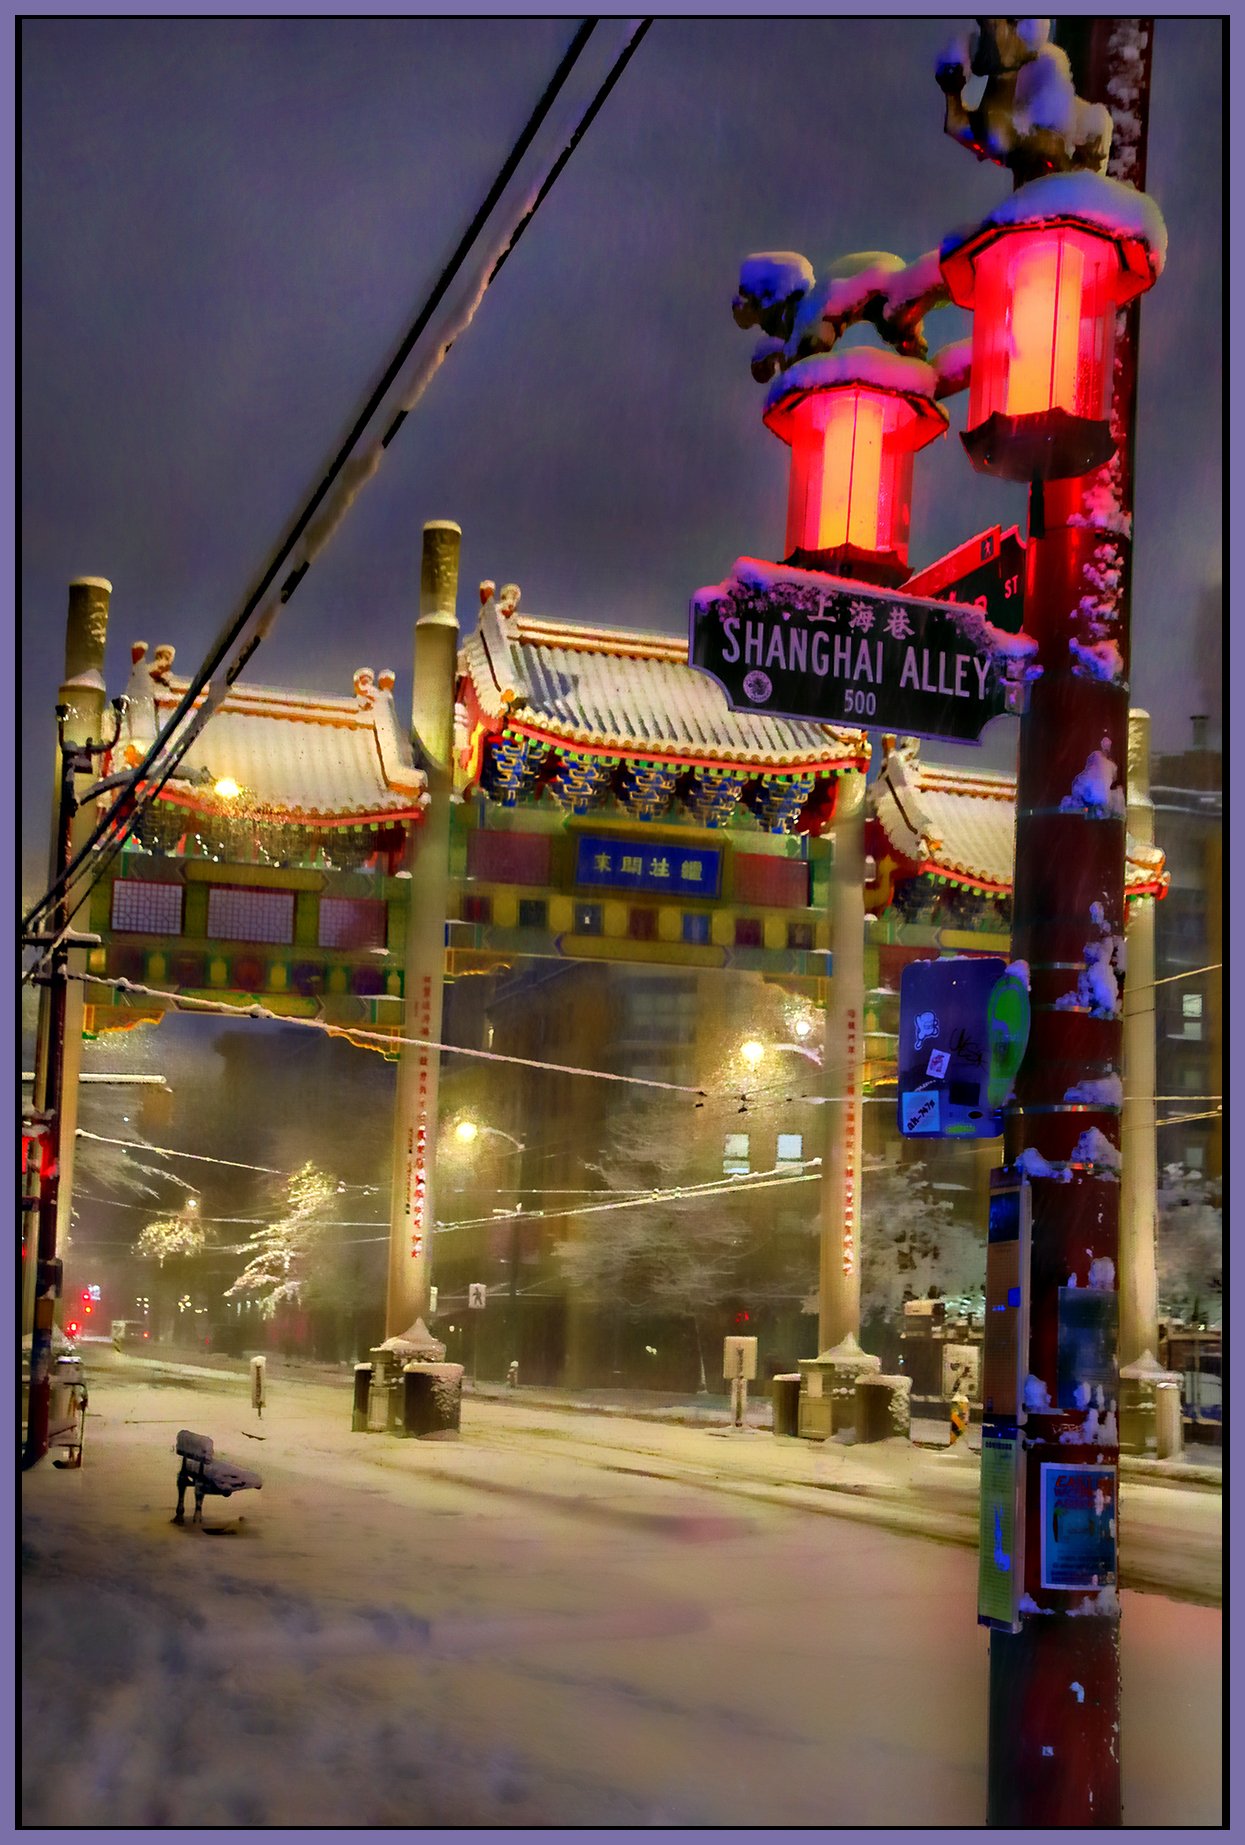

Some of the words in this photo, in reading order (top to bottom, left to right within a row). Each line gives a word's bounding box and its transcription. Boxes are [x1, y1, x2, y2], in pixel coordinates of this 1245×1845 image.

[1004, 574, 1019, 599] ST
[807, 594, 915, 640] 上海巷
[722, 617, 883, 684] SHANGHAI
[900, 646, 992, 700] ALLEY
[844, 689, 876, 717] 500
